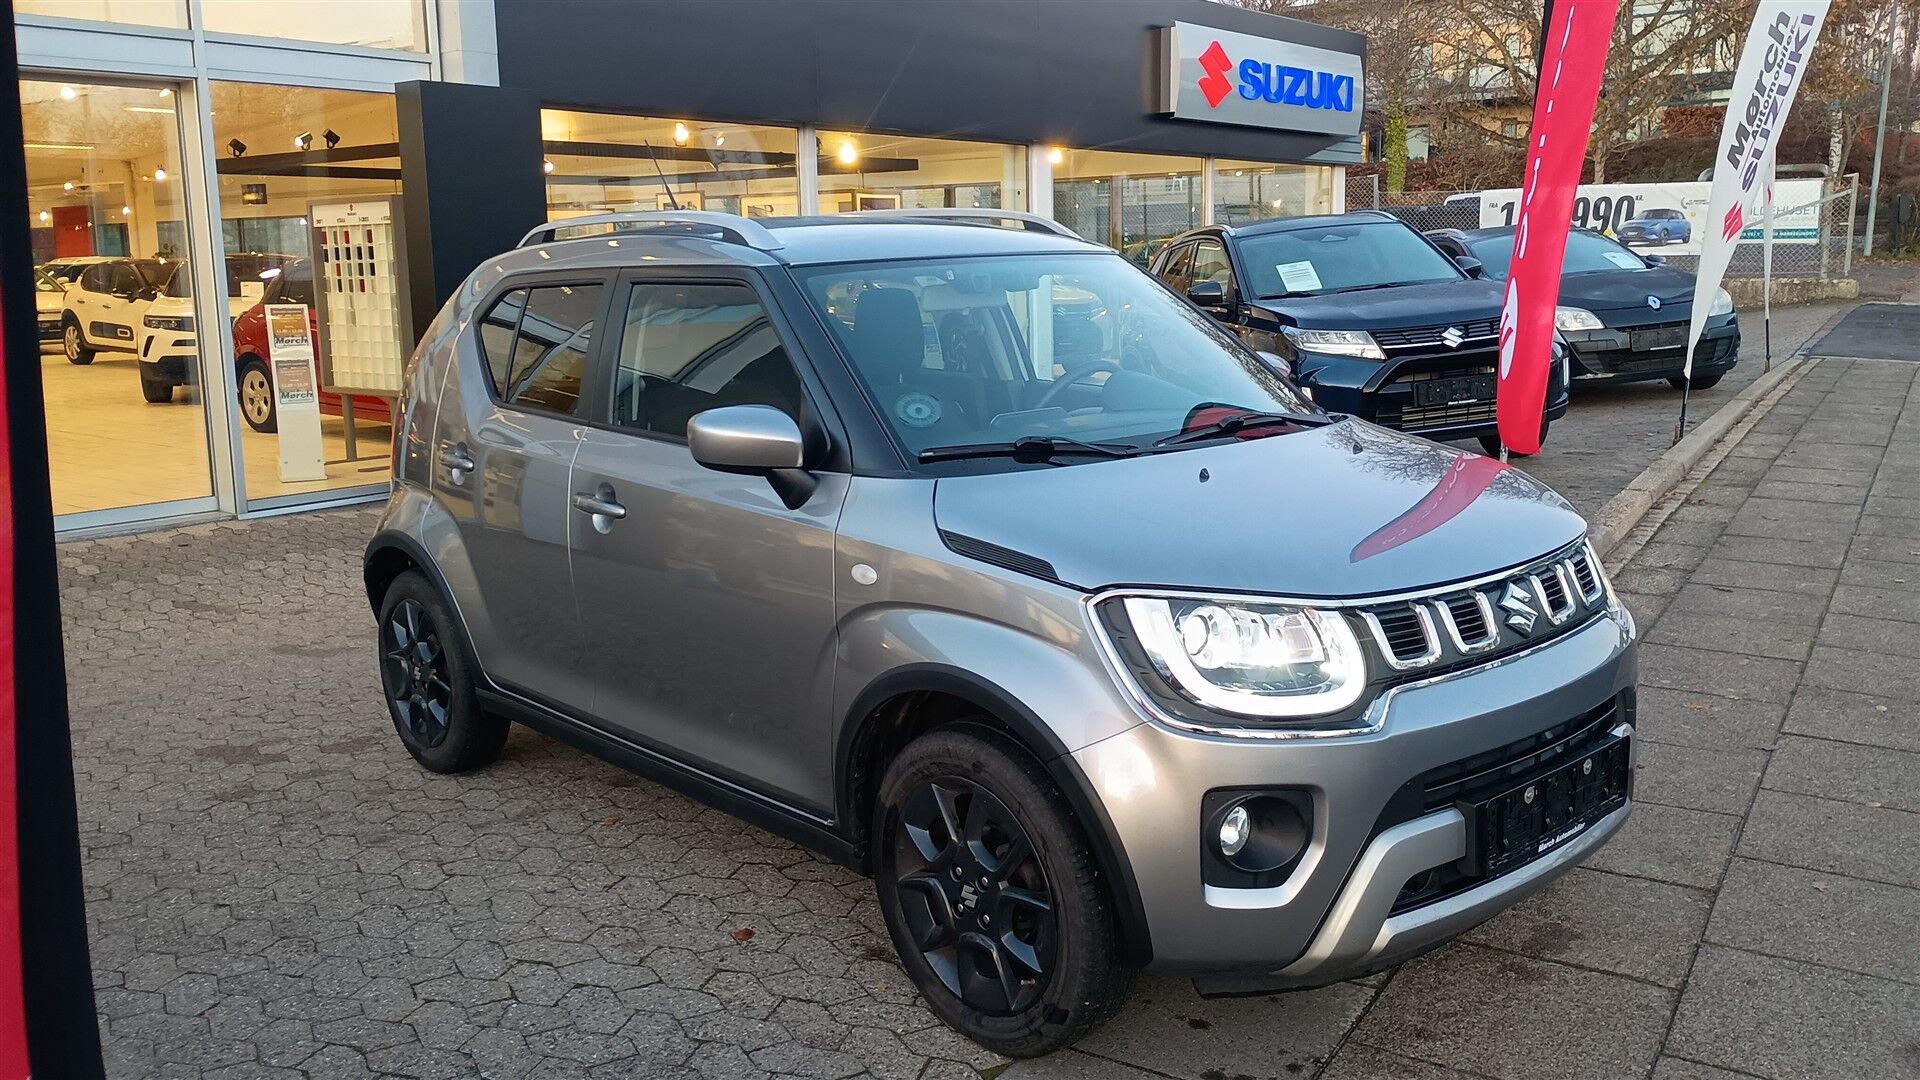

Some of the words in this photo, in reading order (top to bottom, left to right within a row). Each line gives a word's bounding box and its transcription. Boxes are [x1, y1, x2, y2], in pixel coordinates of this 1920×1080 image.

[1238, 58, 1354, 112] SUZUKI
[1727, 11, 1791, 171] Mørch
[1742, 13, 1815, 193] SUZUKI
[1751, 27, 1795, 142] Automobiler
